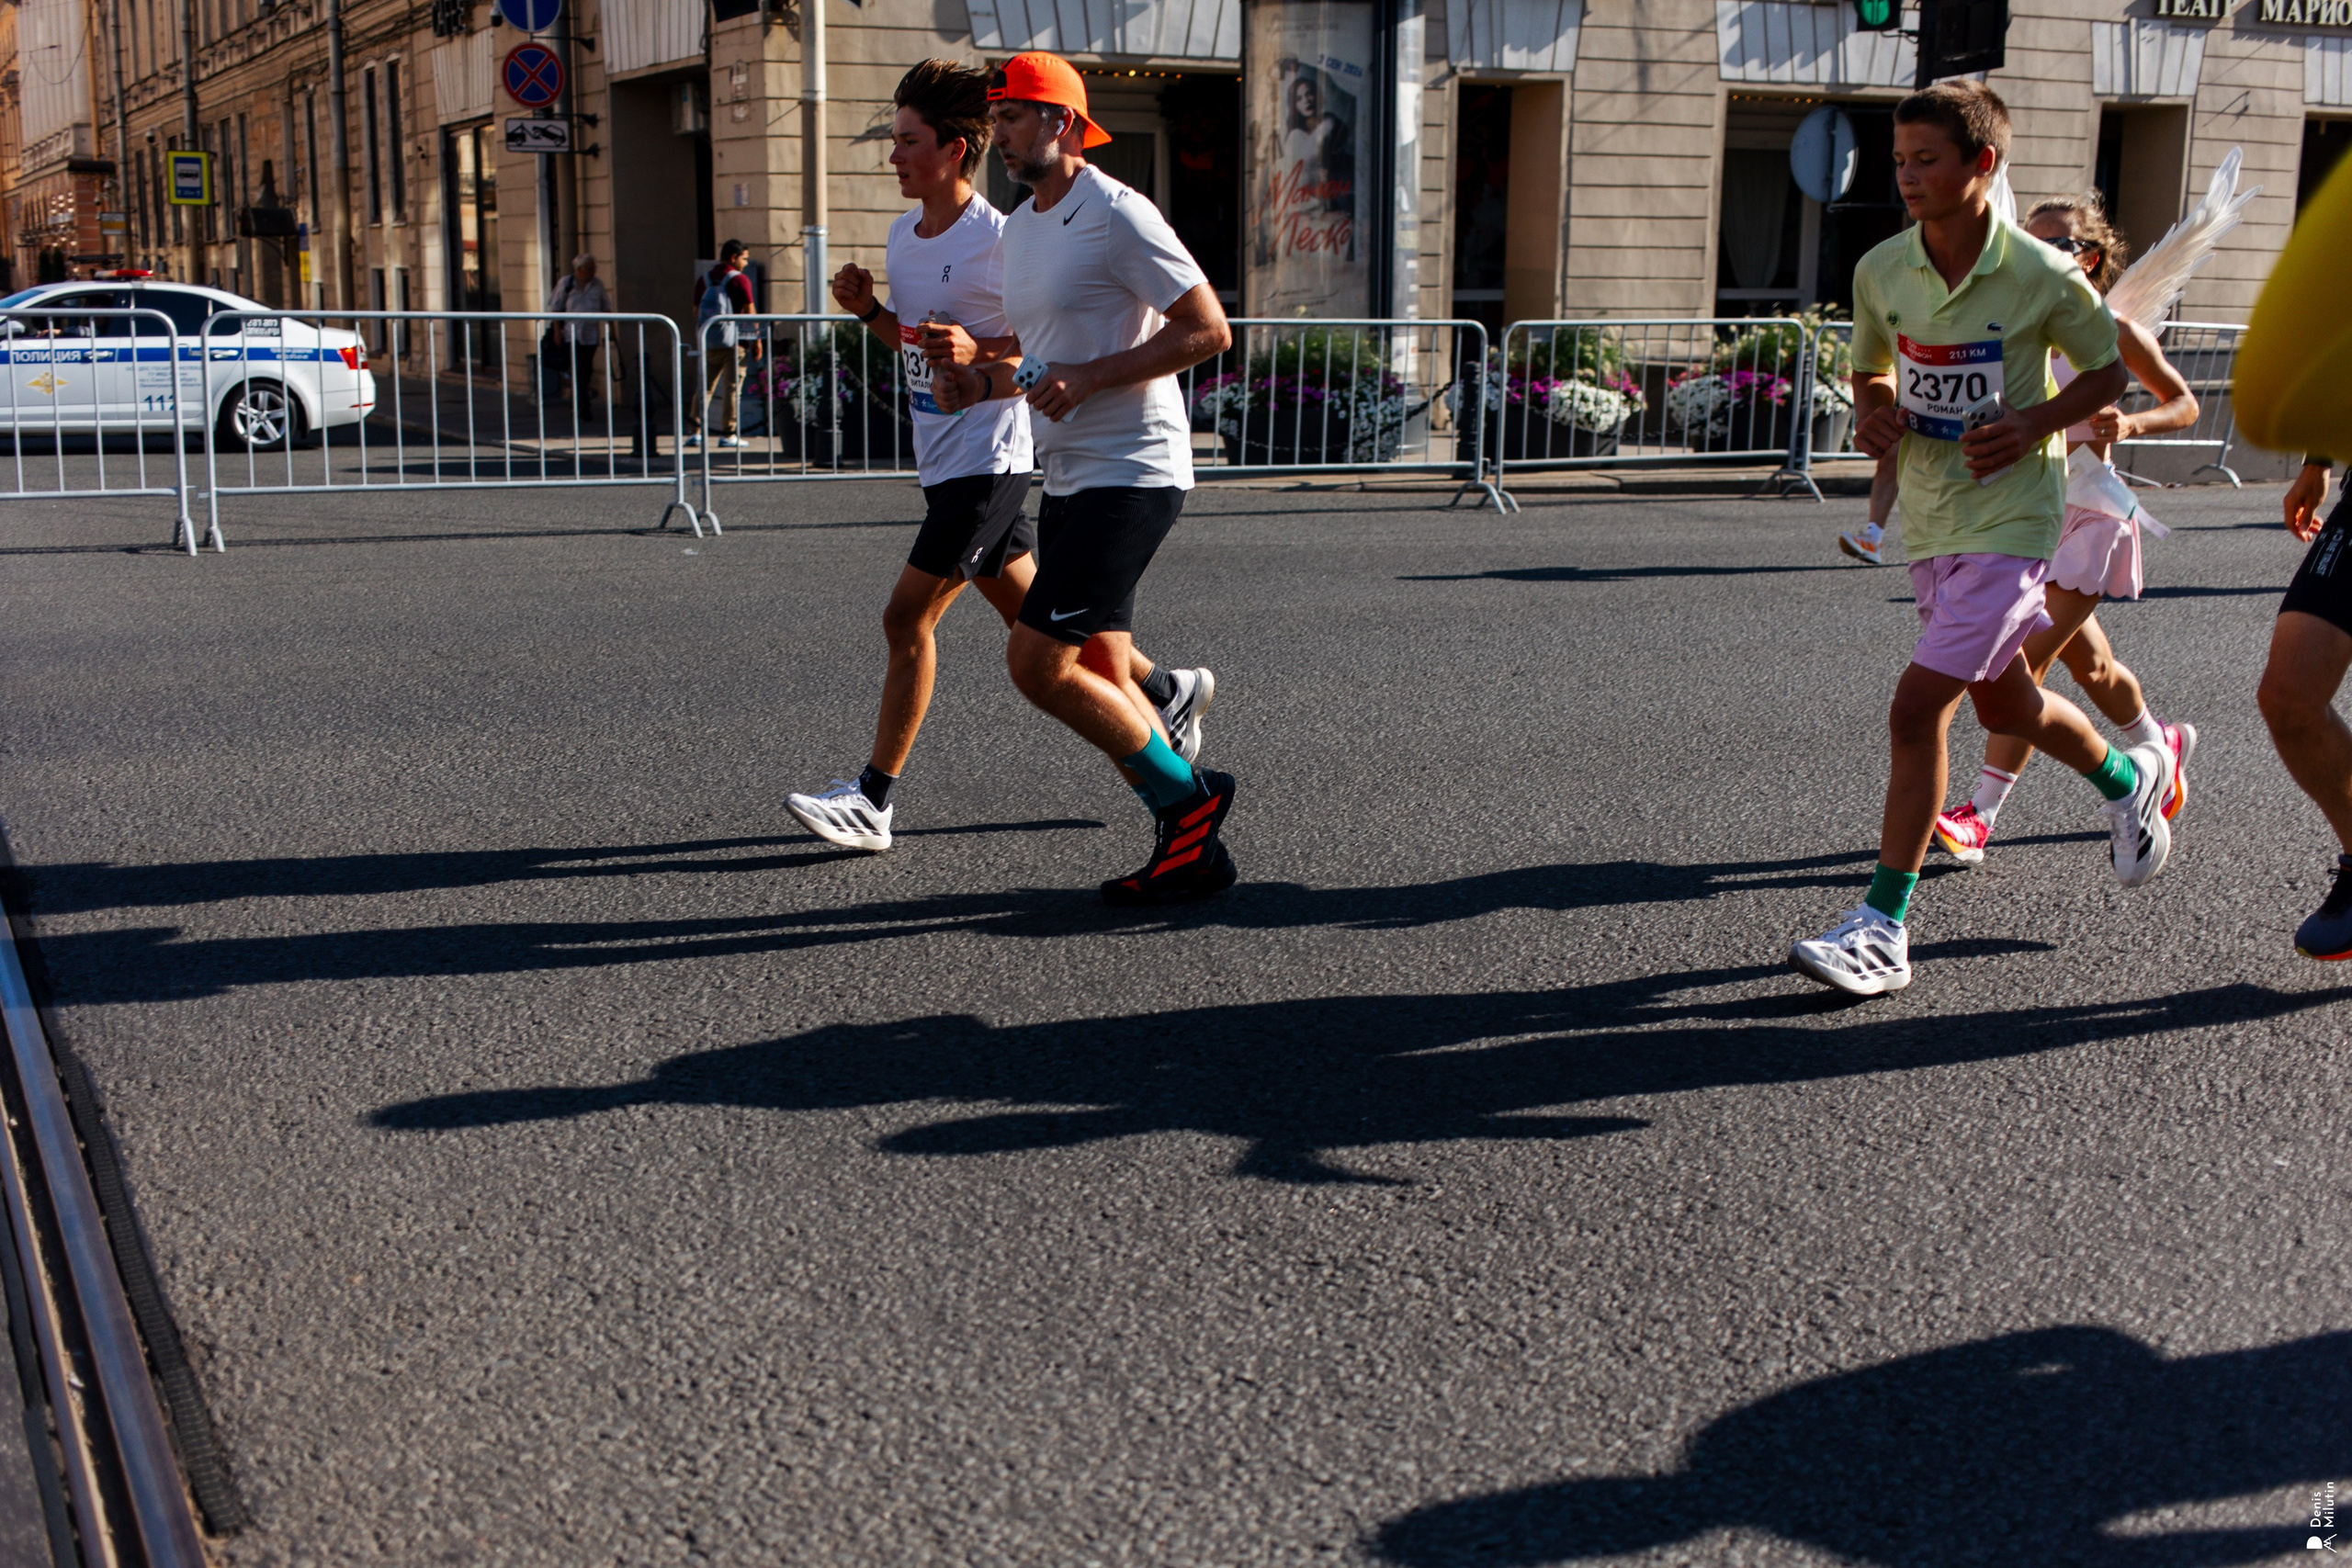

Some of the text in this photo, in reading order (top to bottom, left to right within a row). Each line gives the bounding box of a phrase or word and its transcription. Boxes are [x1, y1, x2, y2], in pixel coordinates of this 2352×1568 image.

[12, 350, 81, 363] ПОЛИЦИЯ
[1949, 350, 1966, 360] 21,1
[903, 349, 932, 379] 237
[1908, 367, 1987, 403] 2370
[1927, 403, 1963, 414] РОМАН
